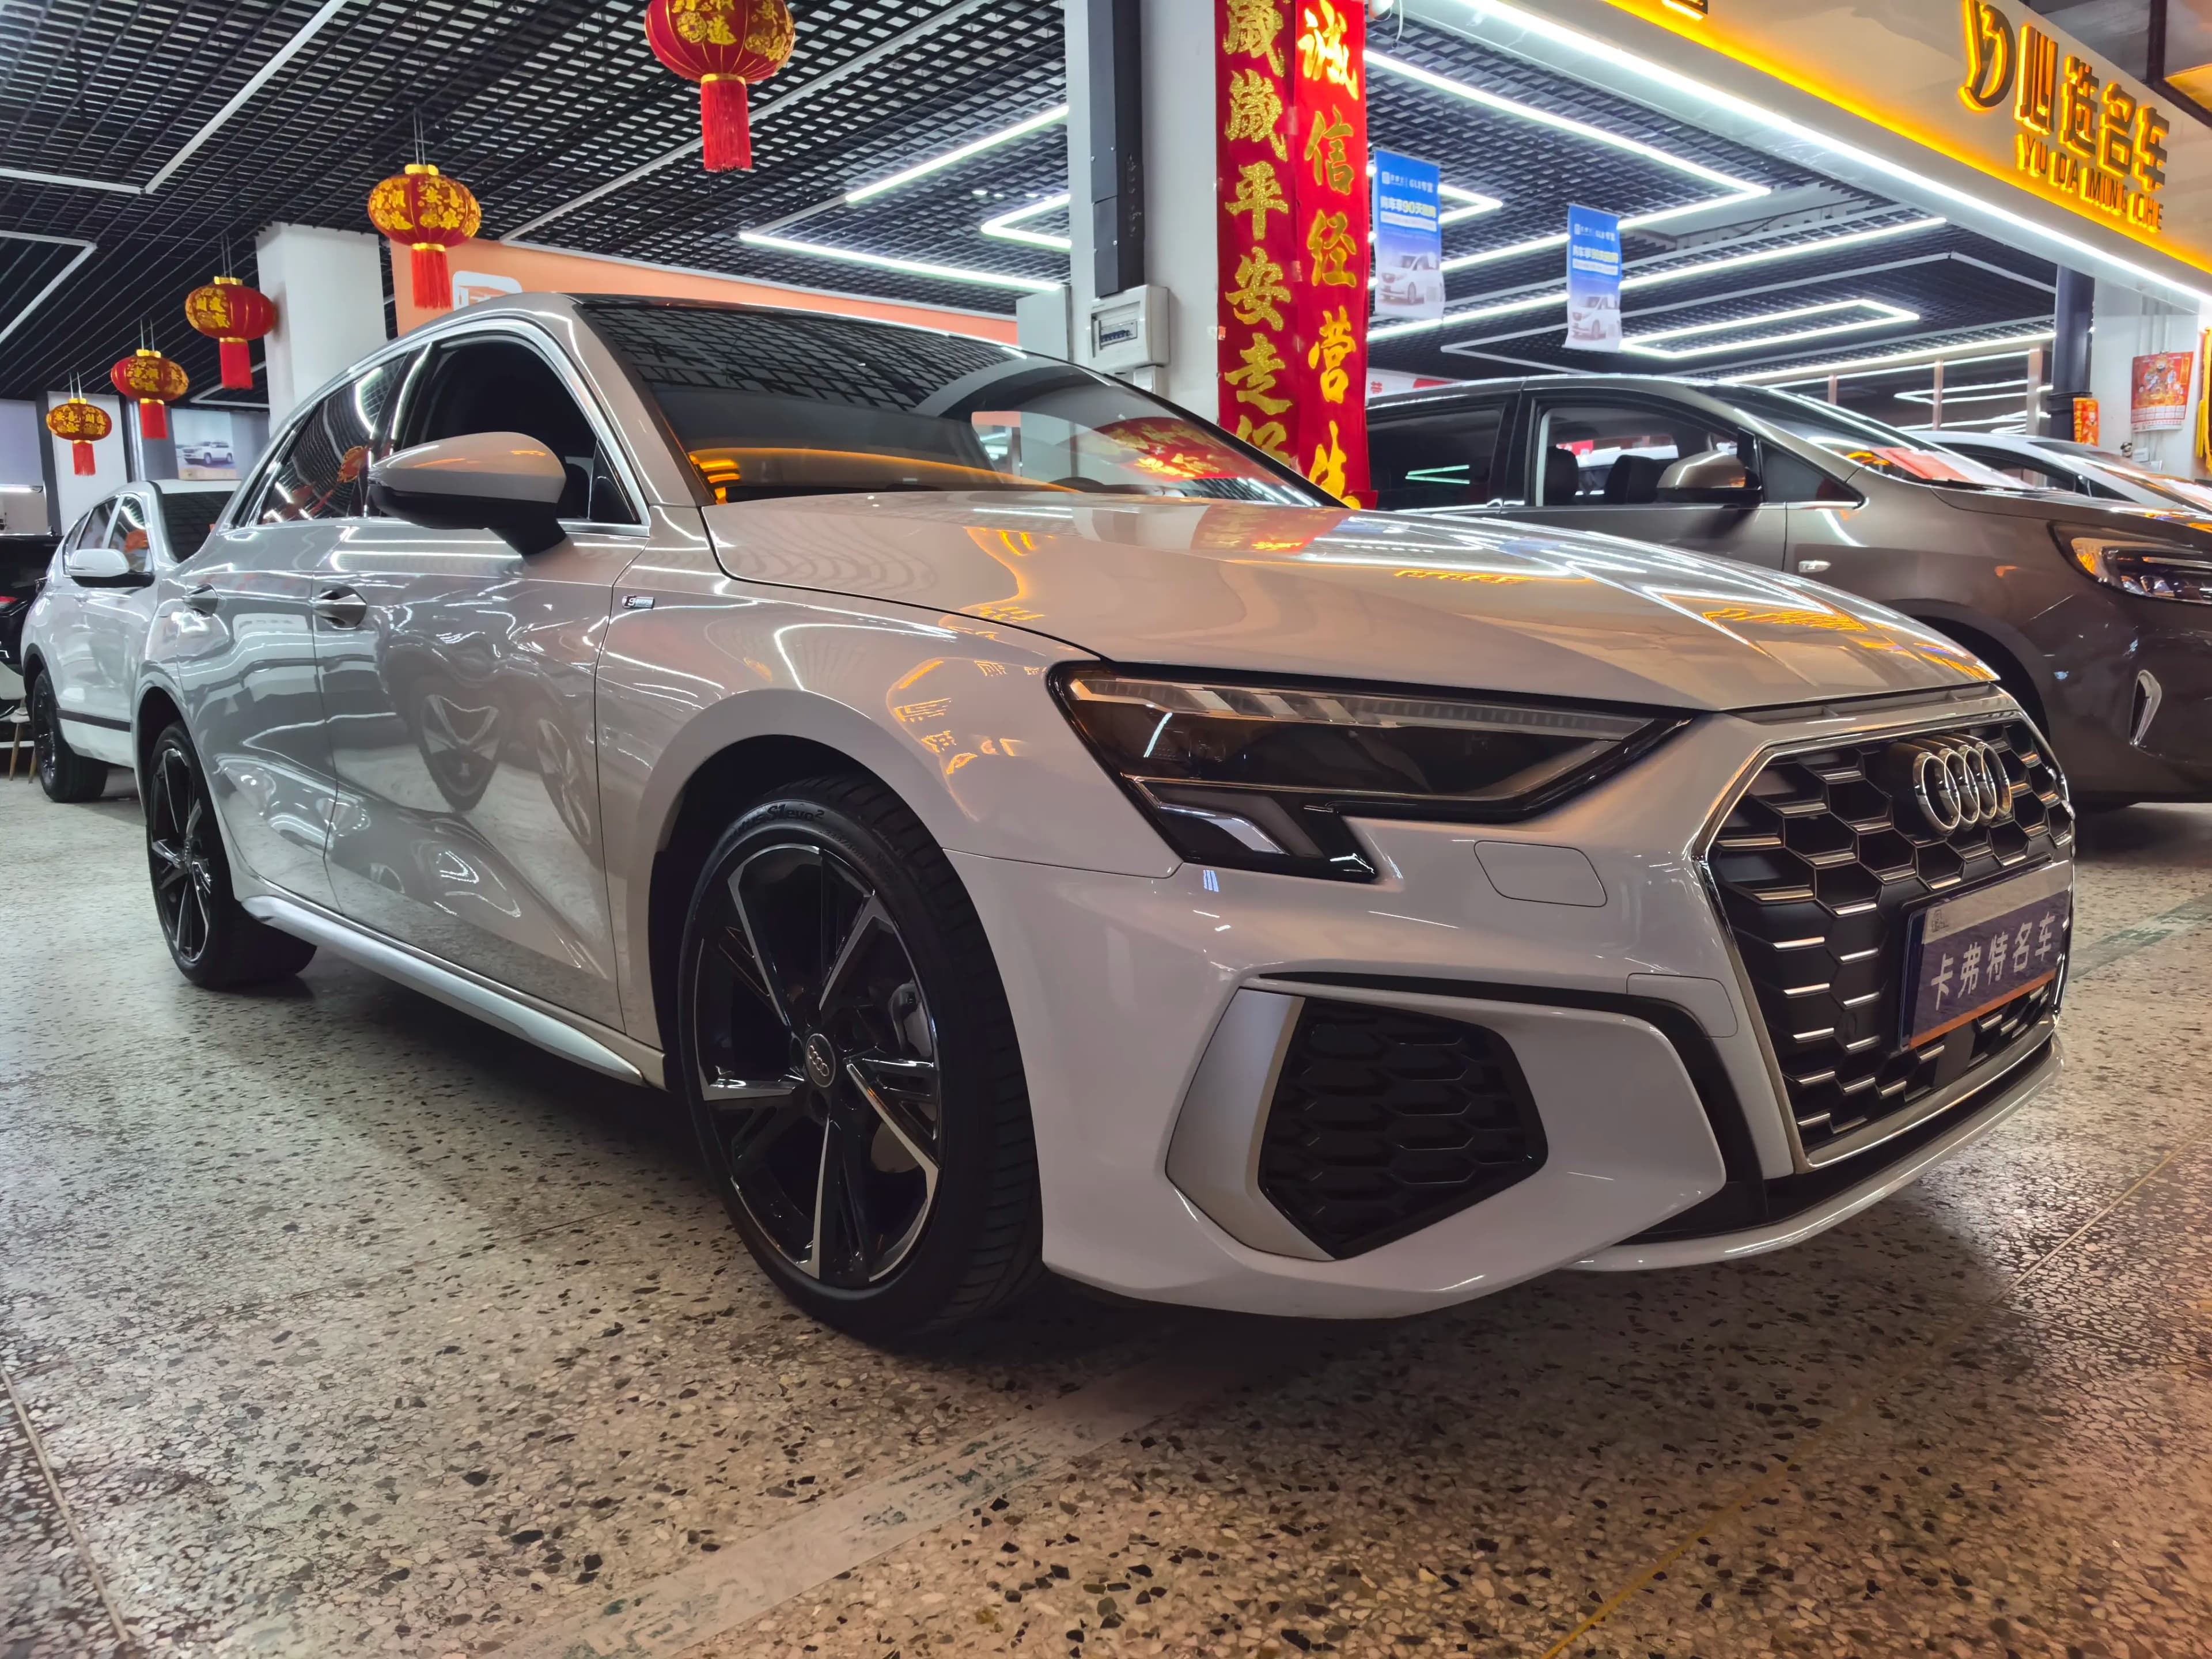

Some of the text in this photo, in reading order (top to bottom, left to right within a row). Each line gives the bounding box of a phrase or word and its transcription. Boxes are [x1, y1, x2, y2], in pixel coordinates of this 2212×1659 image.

[2016, 134, 2164, 233] YU DA MING CHE
